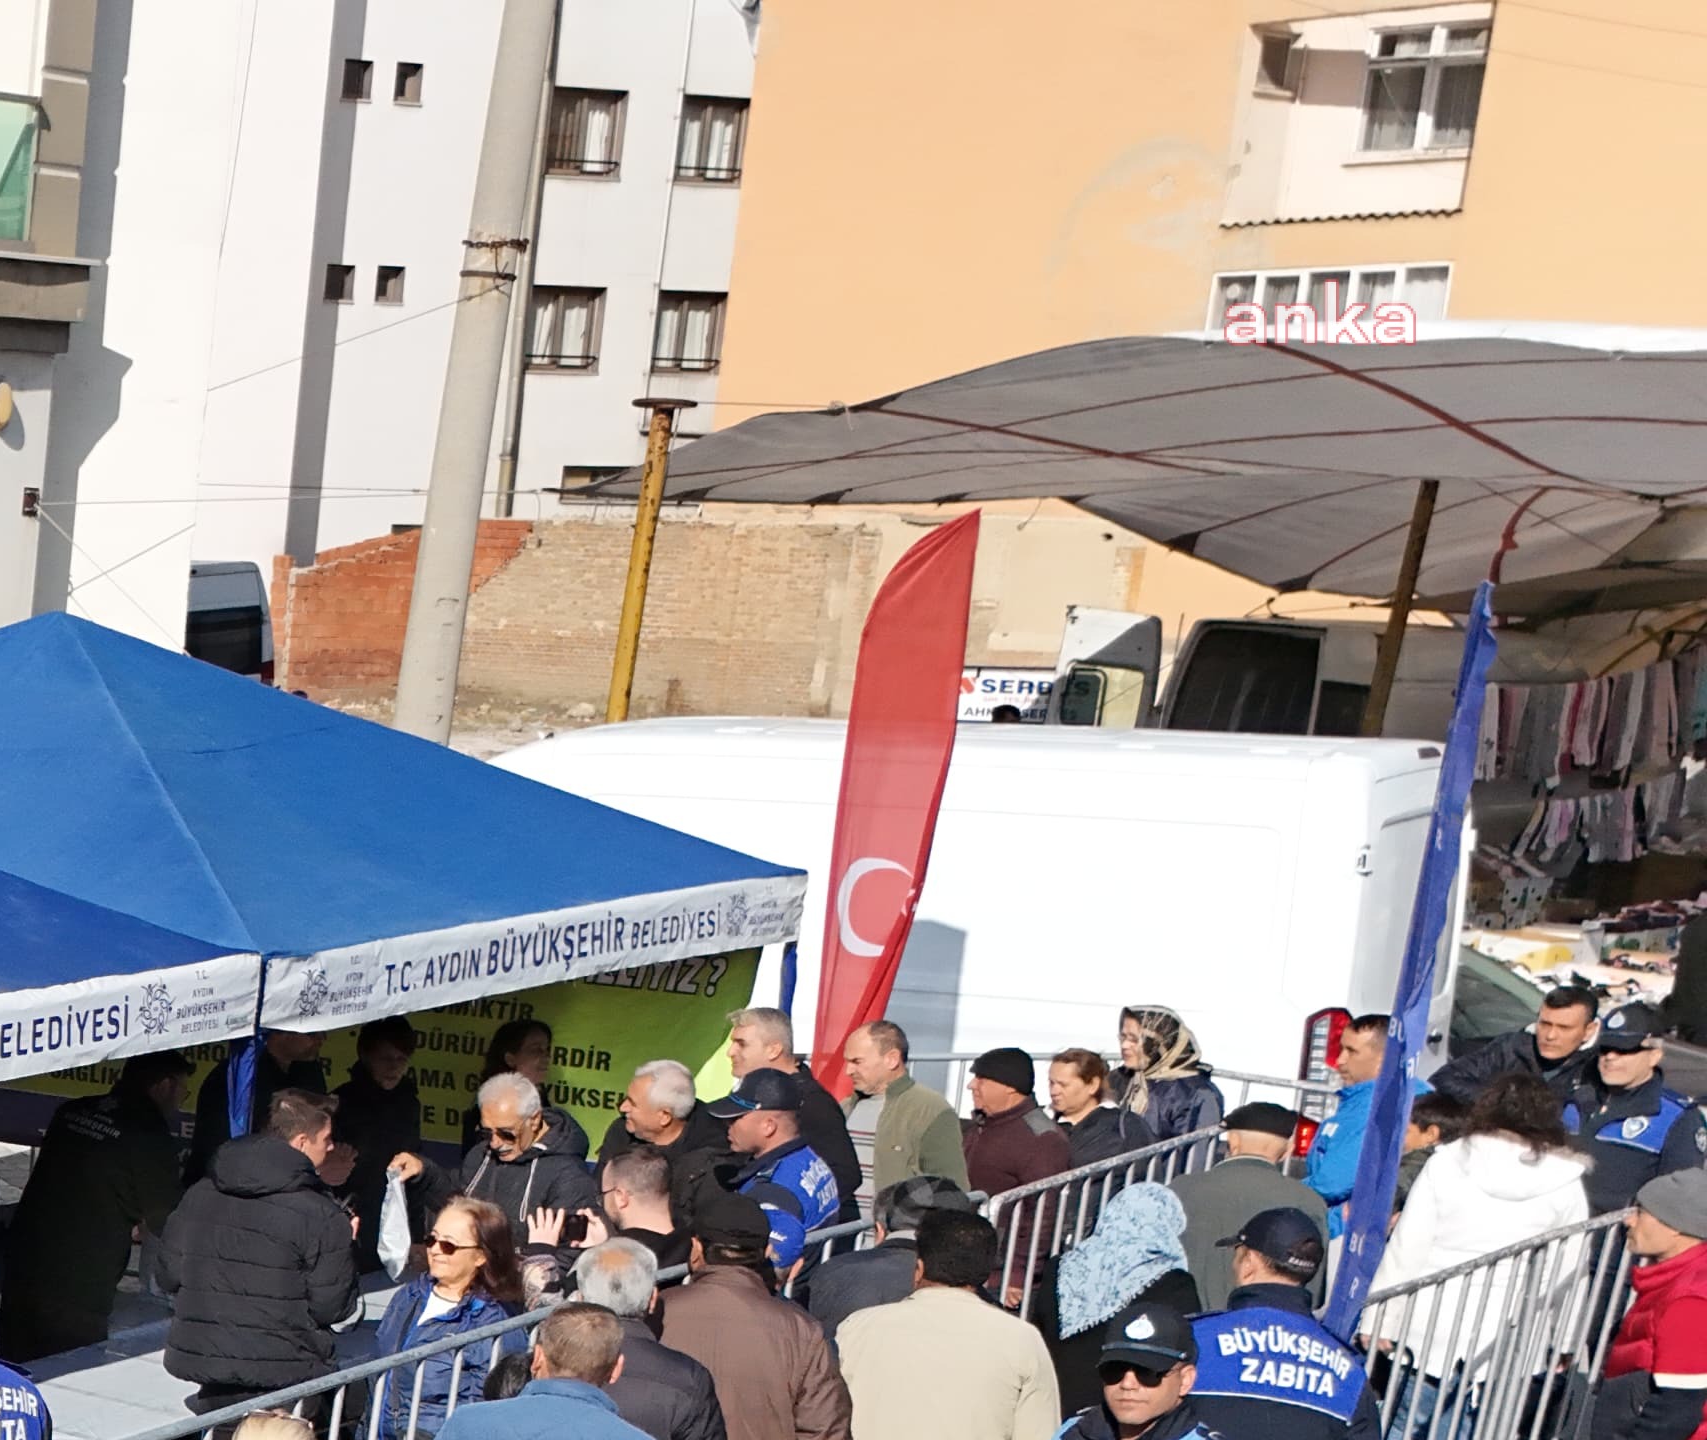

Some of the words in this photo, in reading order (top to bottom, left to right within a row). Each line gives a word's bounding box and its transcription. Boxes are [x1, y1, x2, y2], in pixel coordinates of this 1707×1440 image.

[385, 962, 417, 997] T.C.
[423, 947, 483, 988] AYDIN
[486, 910, 625, 977] BÜYÜKŞEHİR
[630, 901, 722, 951] BELEDİYESİ
[1218, 1325, 1351, 1381] BÜYÜKŞEHİR
[1239, 1358, 1335, 1398] ZABITA
